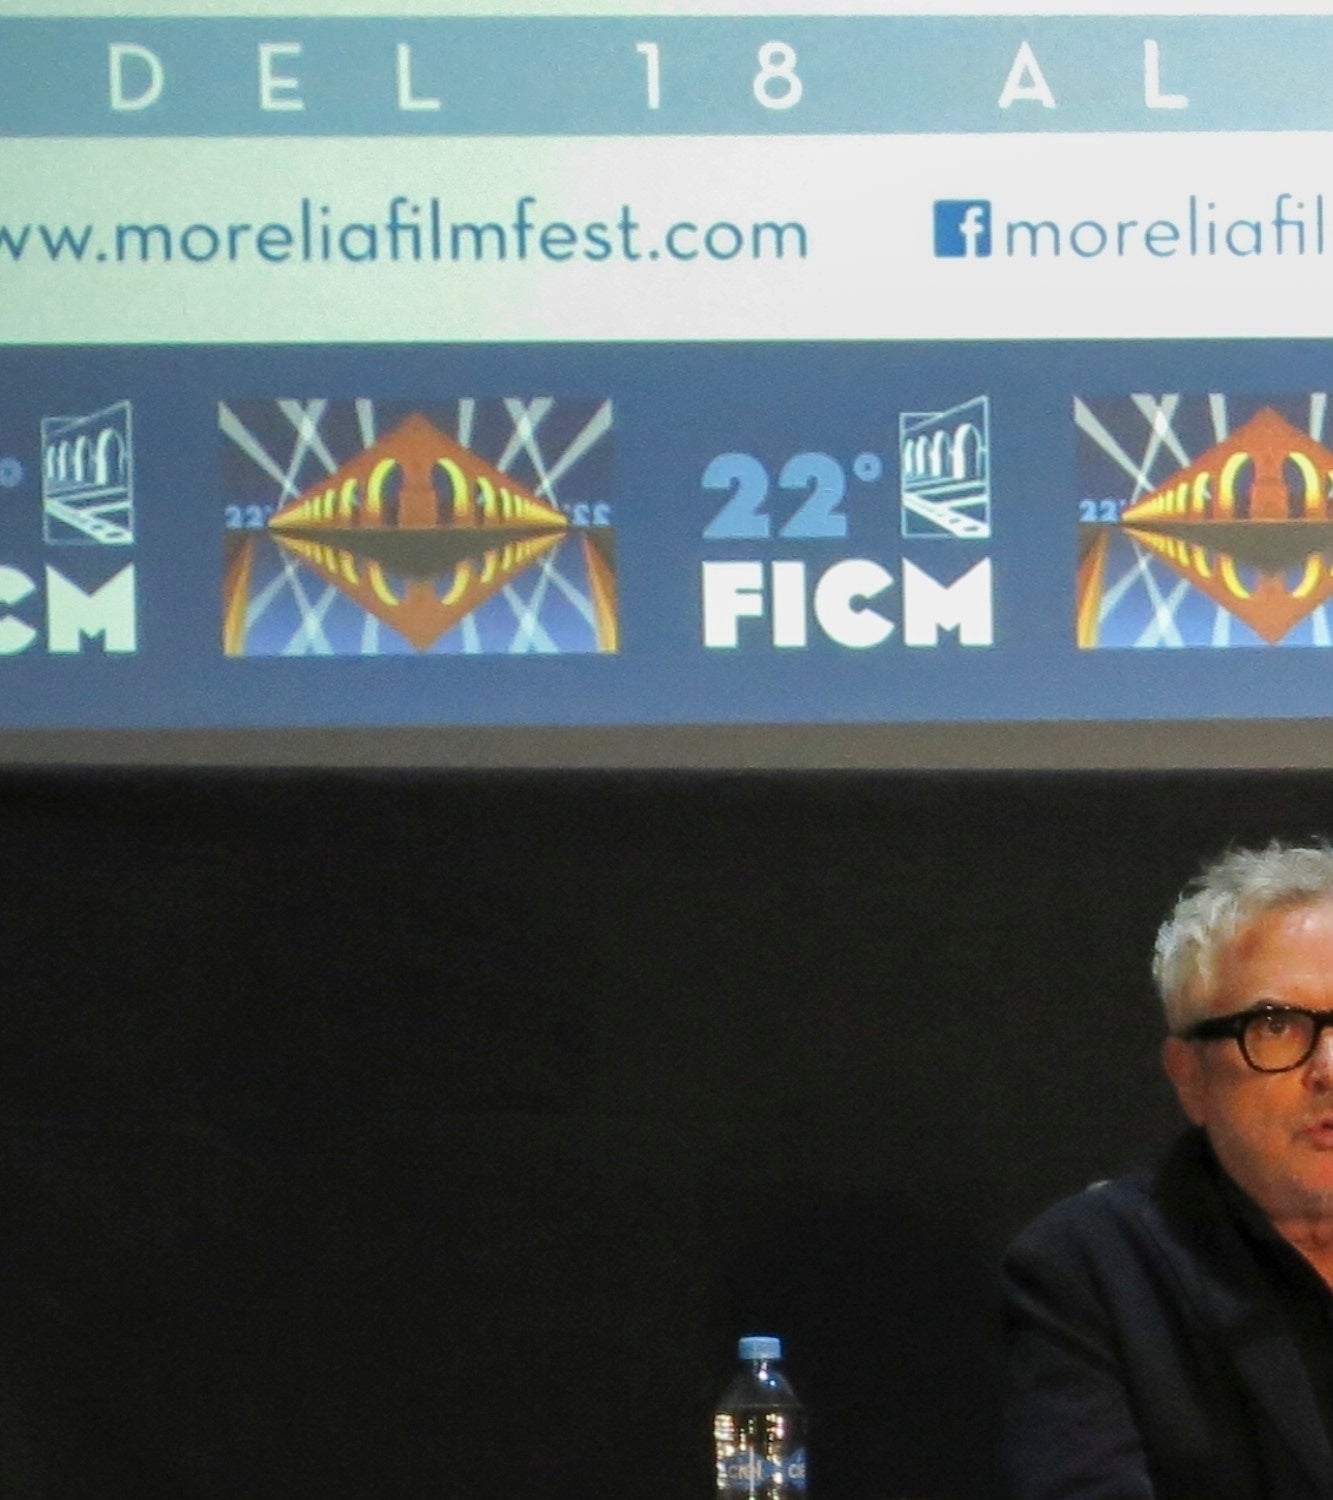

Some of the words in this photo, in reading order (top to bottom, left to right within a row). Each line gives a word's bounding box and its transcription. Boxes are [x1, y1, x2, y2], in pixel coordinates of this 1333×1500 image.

[109, 42, 442, 111] DEL
[636, 41, 804, 110] 18
[998, 40, 1190, 110] AL
[702, 452, 882, 540] 22°
[703, 560, 993, 648] FICM
